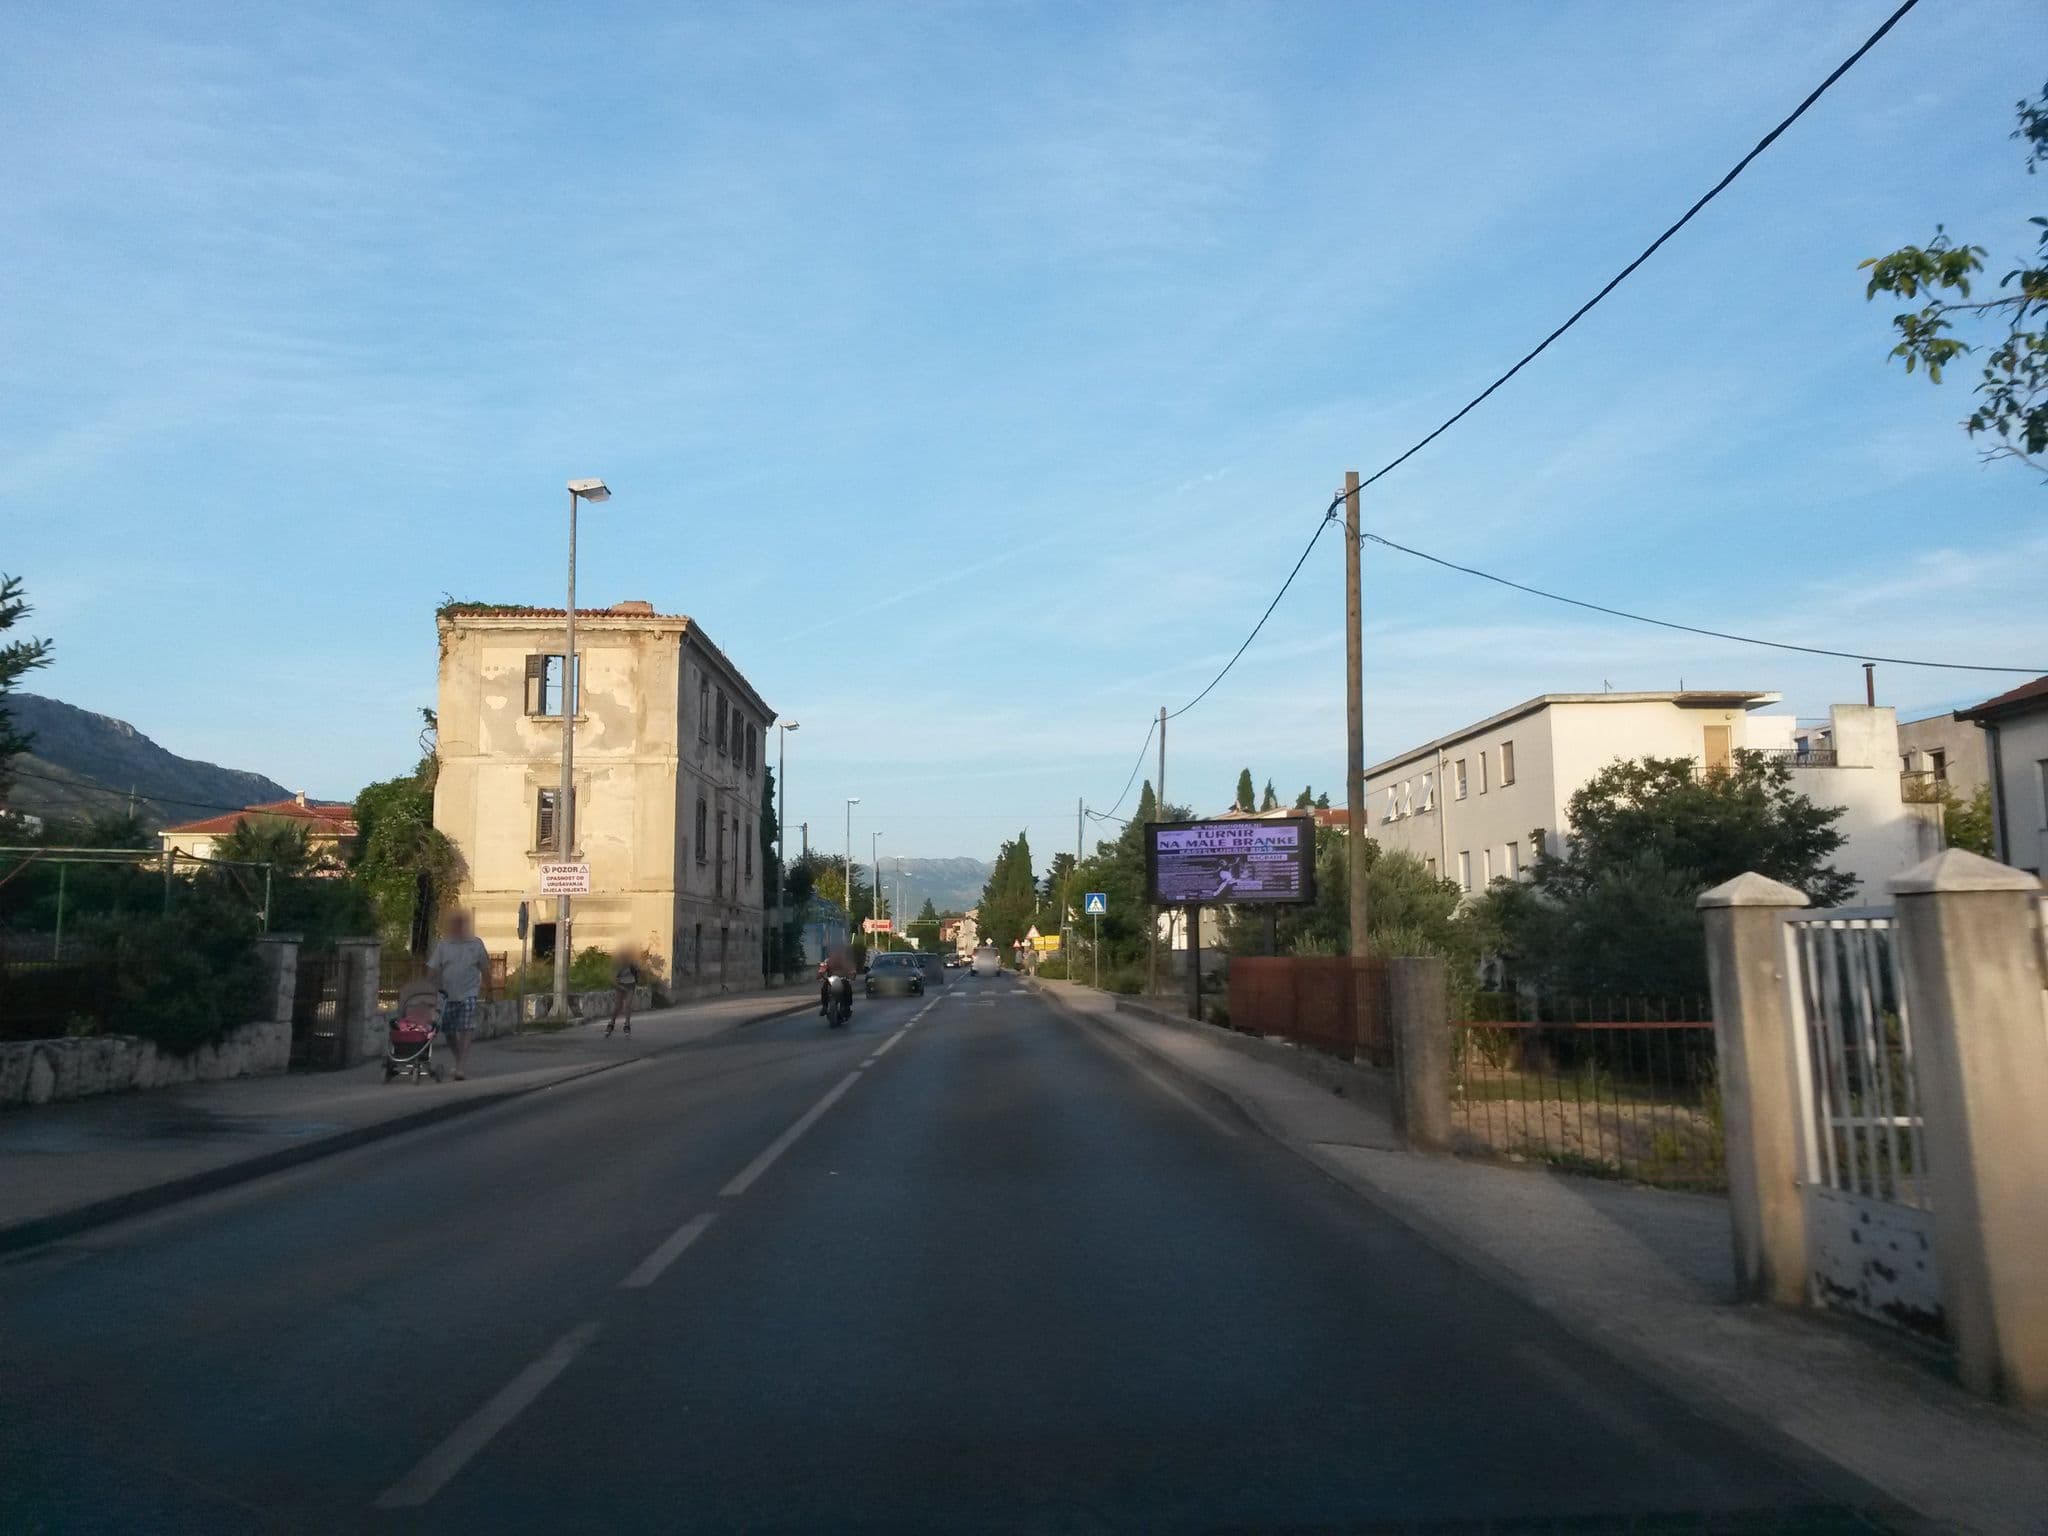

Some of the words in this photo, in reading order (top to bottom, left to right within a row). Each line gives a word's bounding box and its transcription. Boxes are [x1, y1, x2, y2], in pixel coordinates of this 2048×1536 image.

[1196, 830, 1254, 838] TURNIR
[1186, 839, 1226, 847] MALE
[1233, 836, 1296, 846] BRANKE
